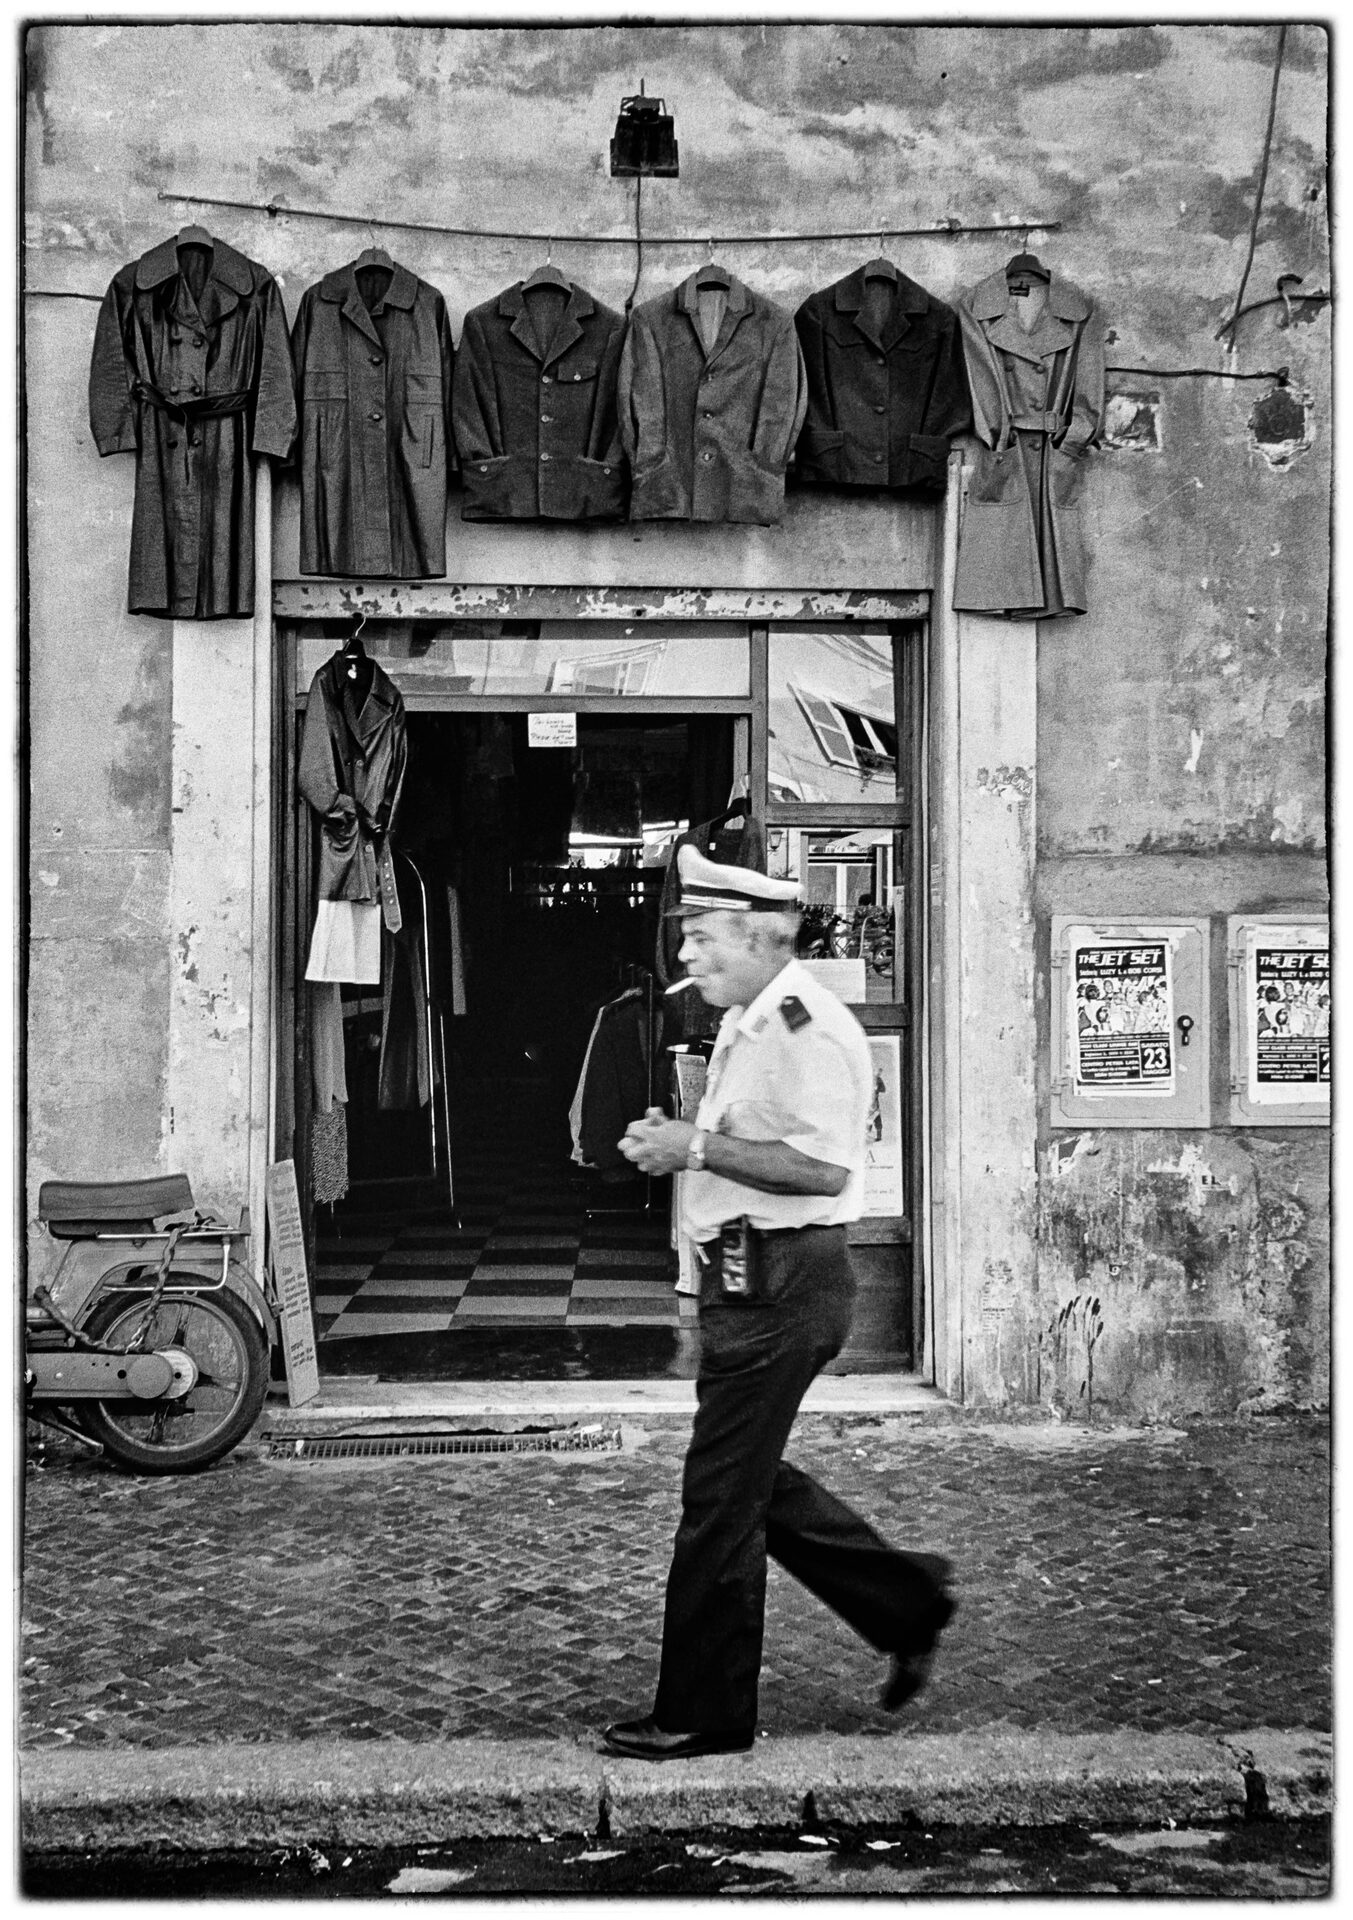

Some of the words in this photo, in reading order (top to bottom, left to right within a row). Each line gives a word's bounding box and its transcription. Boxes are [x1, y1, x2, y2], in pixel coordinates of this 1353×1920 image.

[1078, 954, 1100, 964] THE
[1095, 953, 1127, 967] JET
[1130, 951, 1162, 965] SET
[1260, 956, 1281, 966] THE
[1276, 956, 1309, 969] JET
[1144, 1047, 1167, 1069] 23
